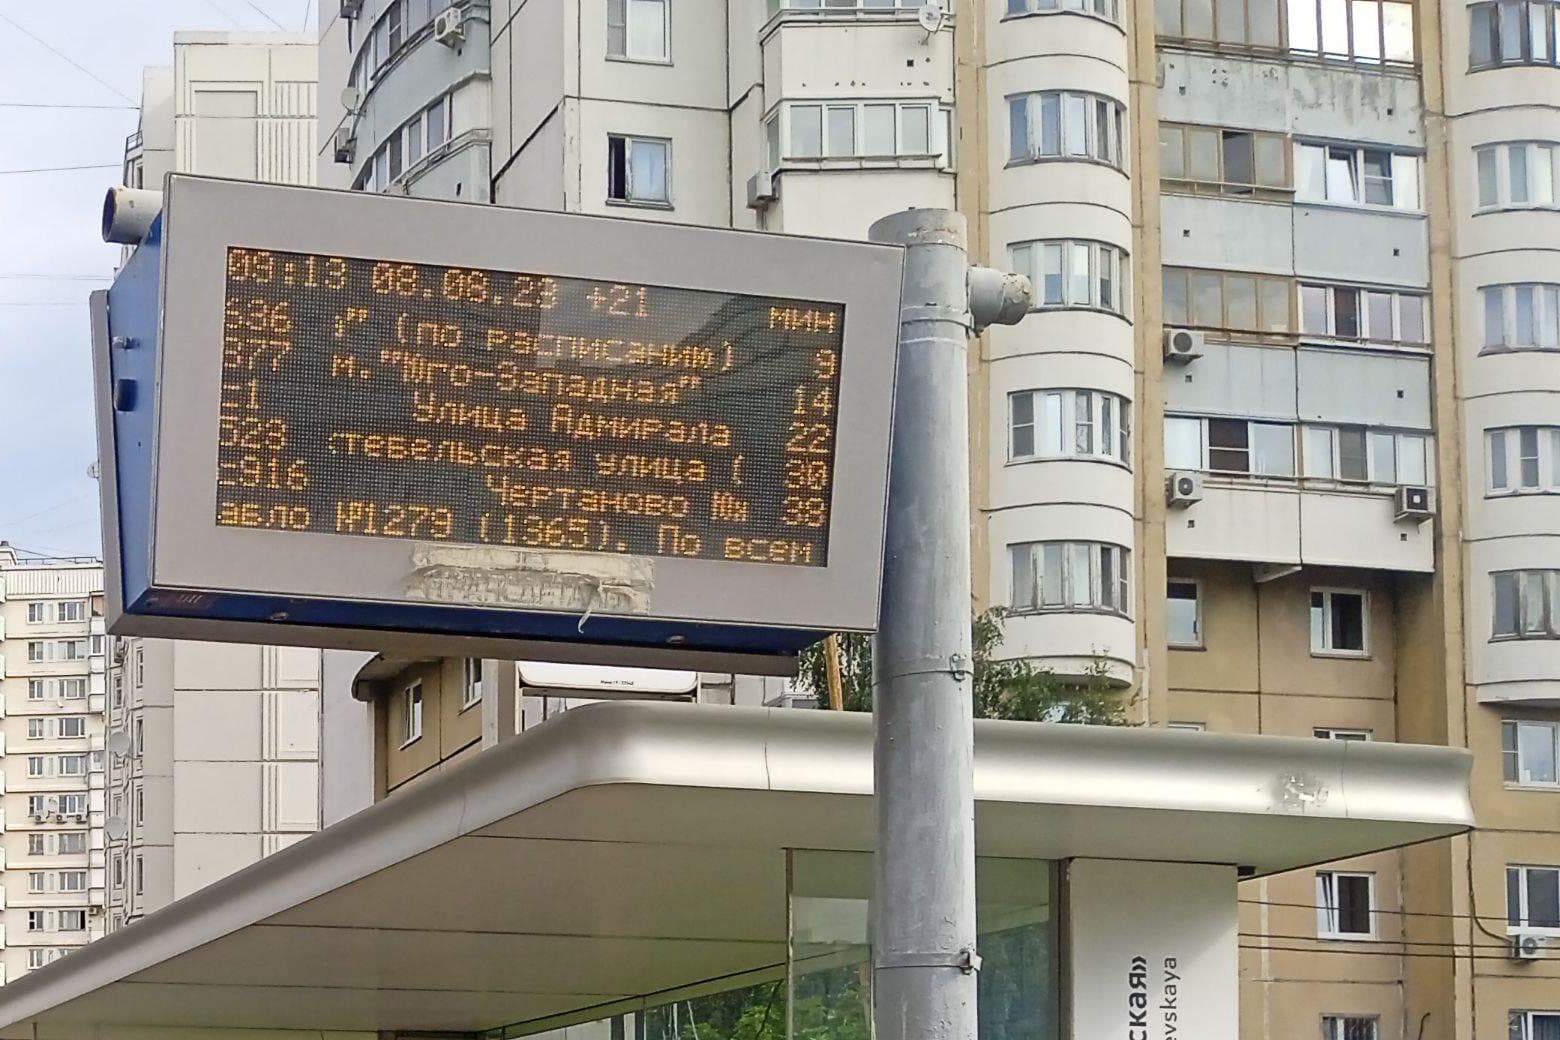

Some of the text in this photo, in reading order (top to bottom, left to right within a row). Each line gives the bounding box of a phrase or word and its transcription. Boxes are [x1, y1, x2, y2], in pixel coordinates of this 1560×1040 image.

[228, 249, 345, 289] 09:13
[586, 285, 648, 318] +21
[396, 311, 462, 348] (по
[487, 328, 734, 371] расписанию)
[379, 350, 702, 404] "Юго-Западная"
[794, 385, 833, 417] 14
[413, 391, 527, 433] Улица
[551, 403, 732, 447] Адмирала
[786, 421, 831, 454] 22
[486, 474, 690, 517] Чертаново
[594, 452, 707, 486] улица
[657, 524, 703, 555] По
[724, 537, 812, 563] всем
